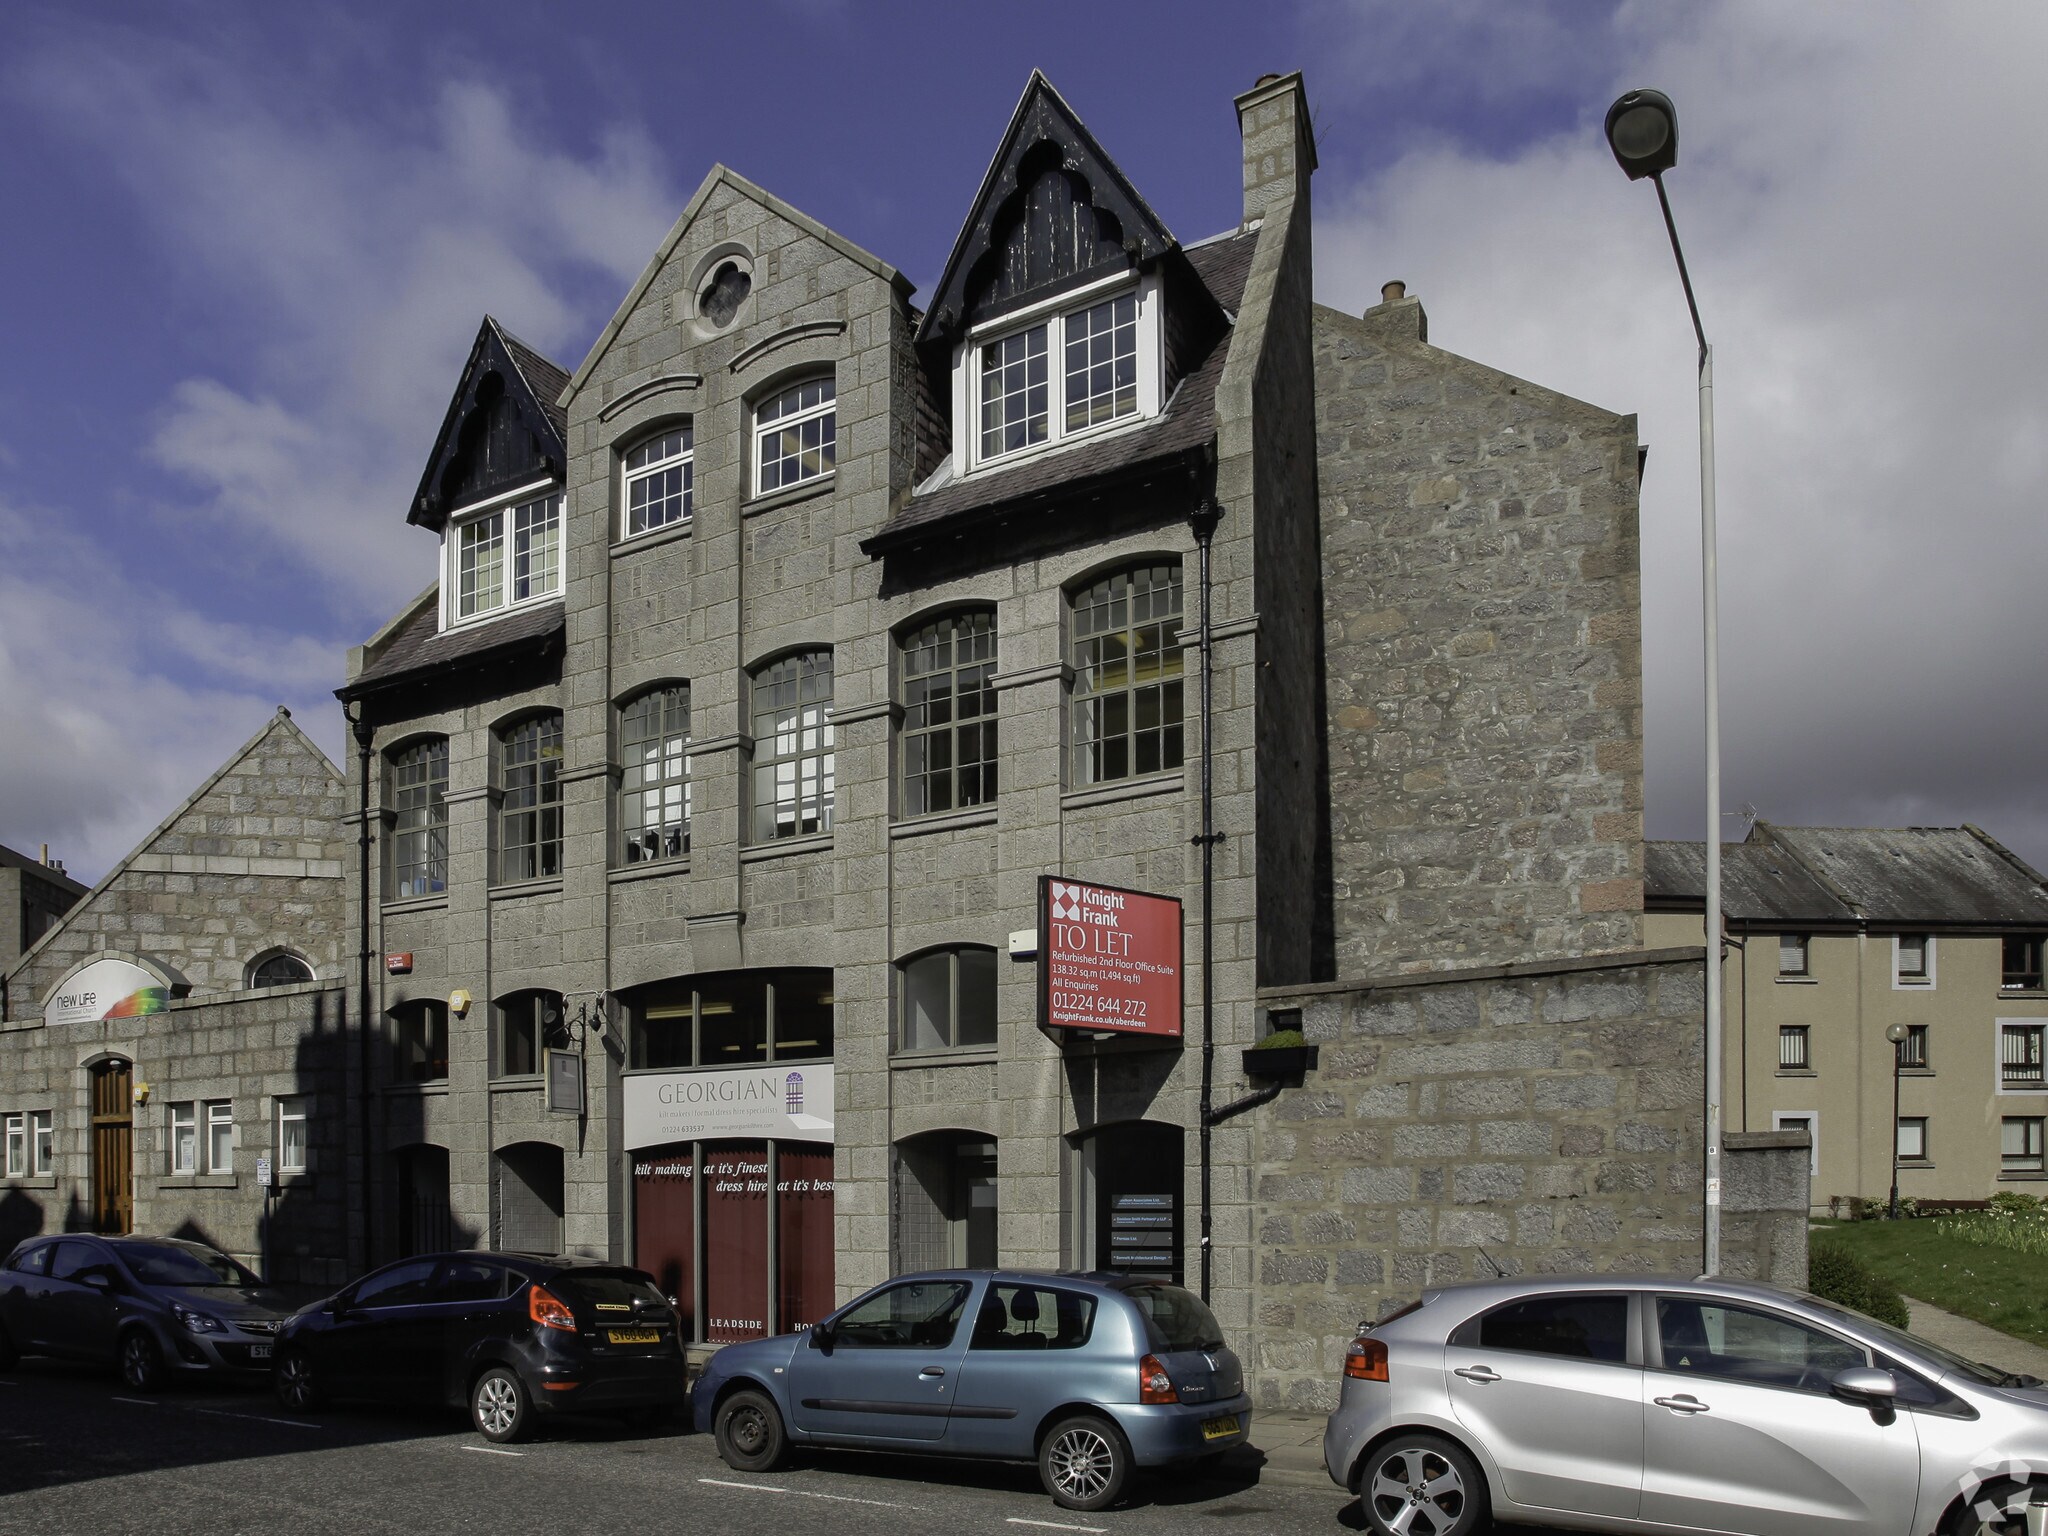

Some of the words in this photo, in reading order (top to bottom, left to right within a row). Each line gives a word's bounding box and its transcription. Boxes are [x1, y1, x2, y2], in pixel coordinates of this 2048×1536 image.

[1083, 888, 1124, 910] Knight
[1083, 907, 1118, 927] Frank
[1052, 923, 1086, 951] TO
[1094, 929, 1133, 956] LET
[1052, 951, 1097, 965] Refurbished
[1099, 957, 1113, 966] 2nd
[1115, 959, 1133, 969] Floor
[1135, 961, 1155, 973] Office
[1157, 964, 1174, 975] Suite
[1052, 963, 1077, 976] 138.32
[1099, 970, 1121, 982] (1,494
[1052, 978, 1063, 987] All
[1064, 979, 1098, 992] Enquiries
[1053, 991, 1093, 1011] 01224
[1097, 996, 1120, 1014] 644
[1124, 999, 1147, 1017] 272
[1053, 1010, 1146, 1028] KnightFrank.co.uk/aberdeen
[658, 1077, 777, 1104] GEORGIAN
[659, 1110, 669, 1118] kilt
[694, 1109, 715, 1117] formal
[715, 1108, 731, 1116] dress
[746, 1106, 778, 1117] specialists
[681, 1124, 705, 1133] 633537
[635, 1163, 651, 1175] kilt
[655, 1163, 693, 1177] making
[703, 1164, 715, 1174] at
[718, 1162, 734, 1174] it's
[733, 1162, 768, 1176] finest
[716, 1180, 743, 1192] dress
[747, 1180, 767, 1192] hire
[777, 1181, 789, 1191] at
[793, 1180, 809, 1191] it's
[710, 1318, 762, 1329] LEADSIDE
